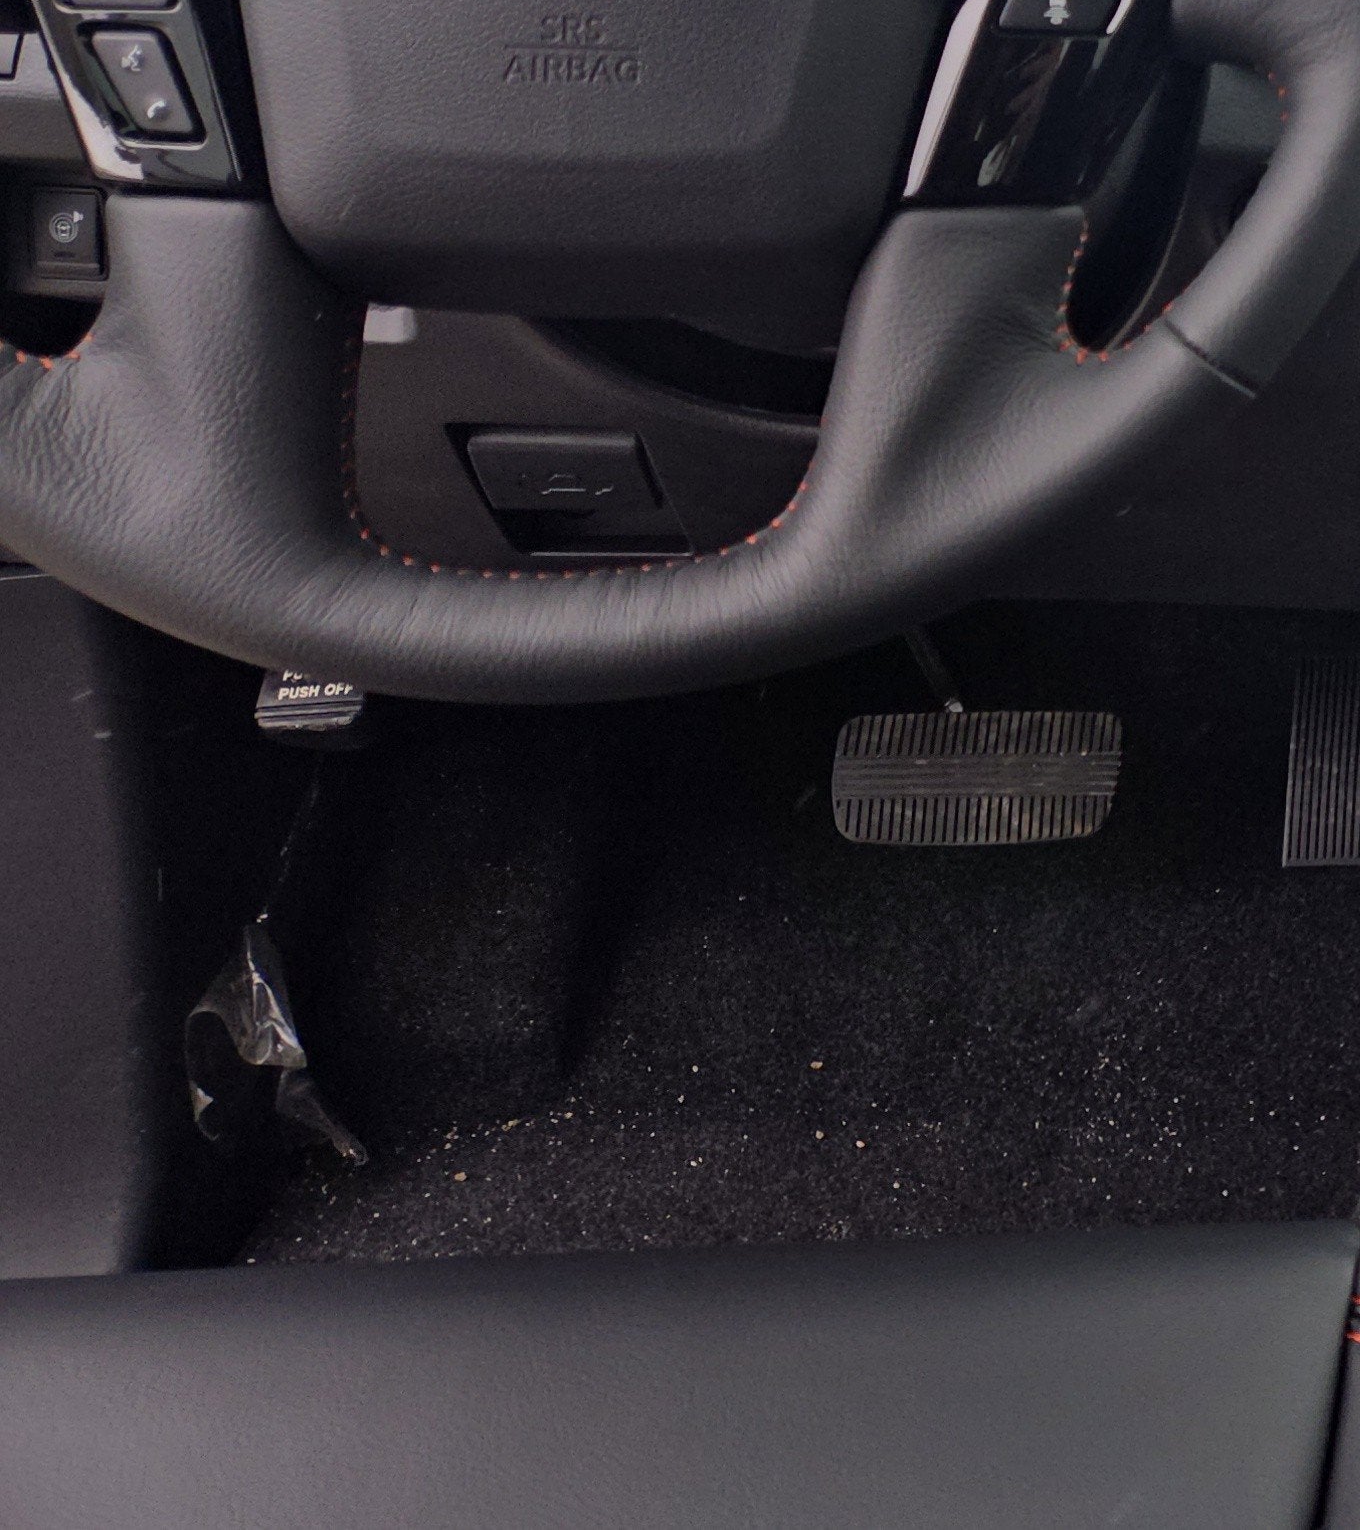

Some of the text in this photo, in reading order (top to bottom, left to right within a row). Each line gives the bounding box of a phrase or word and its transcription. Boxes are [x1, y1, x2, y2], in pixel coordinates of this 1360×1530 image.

[539, 15, 604, 43] SRS
[502, 53, 646, 84] AIRBAG
[277, 683, 320, 700] PUSH
